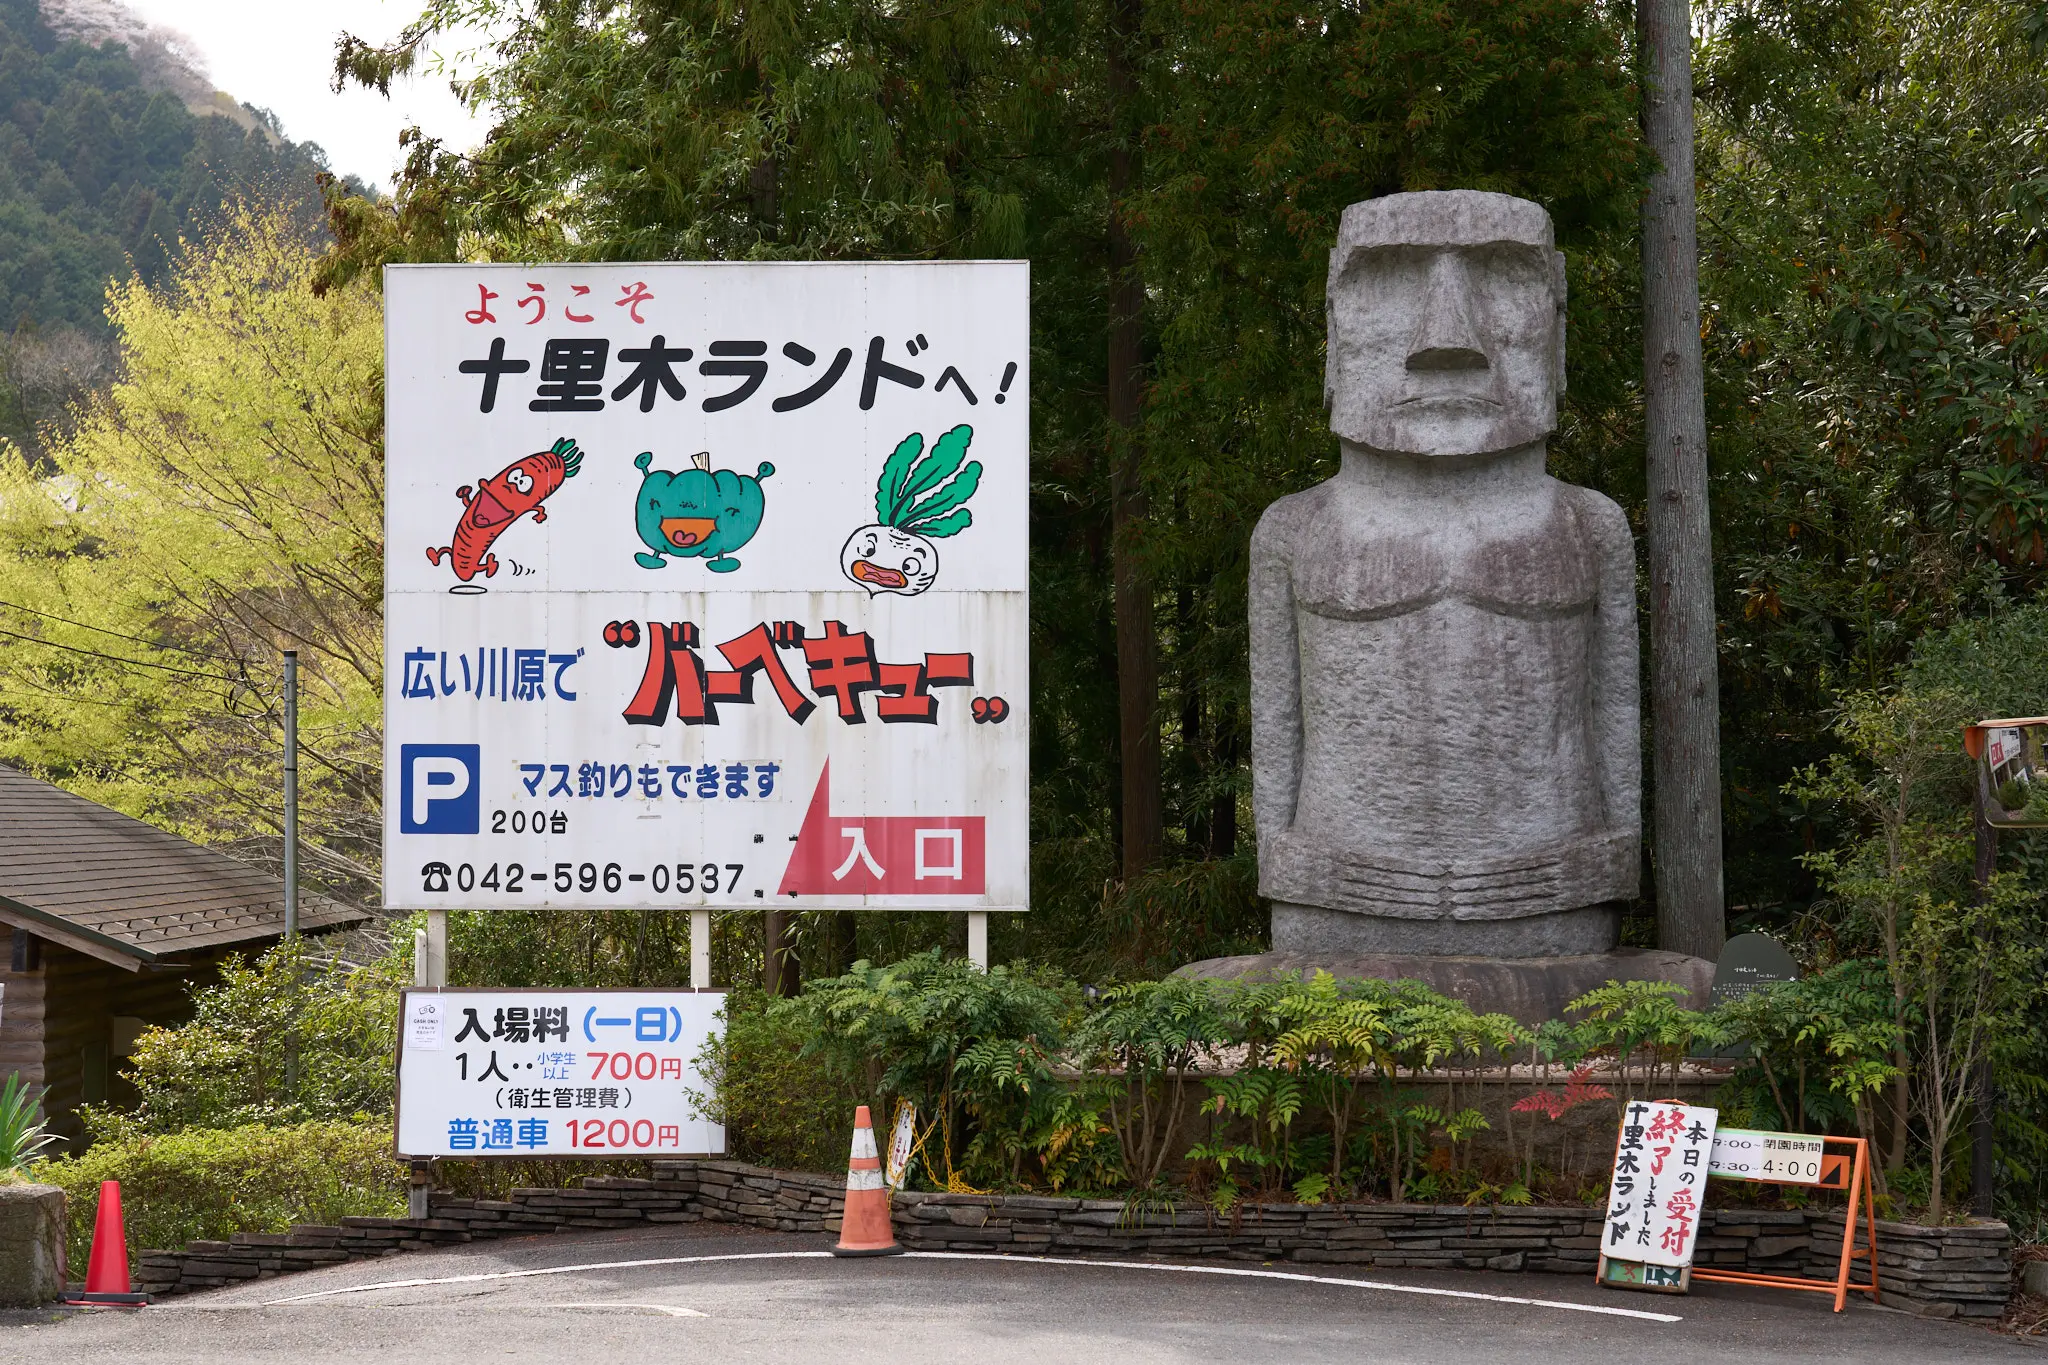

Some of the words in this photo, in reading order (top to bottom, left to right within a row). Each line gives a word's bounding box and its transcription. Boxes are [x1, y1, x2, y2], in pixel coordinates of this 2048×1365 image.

[465, 282, 654, 325] ようこそ
[401, 646, 585, 703] 広い川原で
[412, 757, 470, 825] P
[519, 763, 780, 799] マス釣りもできます
[491, 809, 569, 835] 200台
[832, 827, 963, 881] 入口
[457, 862, 744, 894] 042-596-0537
[454, 1006, 570, 1043] 入場料
[583, 1006, 683, 1043] (一日)
[537, 1052, 577, 1065] 小学生
[543, 1067, 569, 1080] 以上
[586, 1052, 682, 1081] 700円
[495, 1087, 632, 1109] (衛生管理費)
[448, 1117, 549, 1150] 普通車
[565, 1119, 680, 1148] 1200円
[1763, 1139, 1821, 1153] 閉園時間
[1611, 1103, 1649, 1246] 十里木ランド
[1637, 1110, 1687, 1247] 終了しました
[1660, 1121, 1709, 1257] 本日の受付
